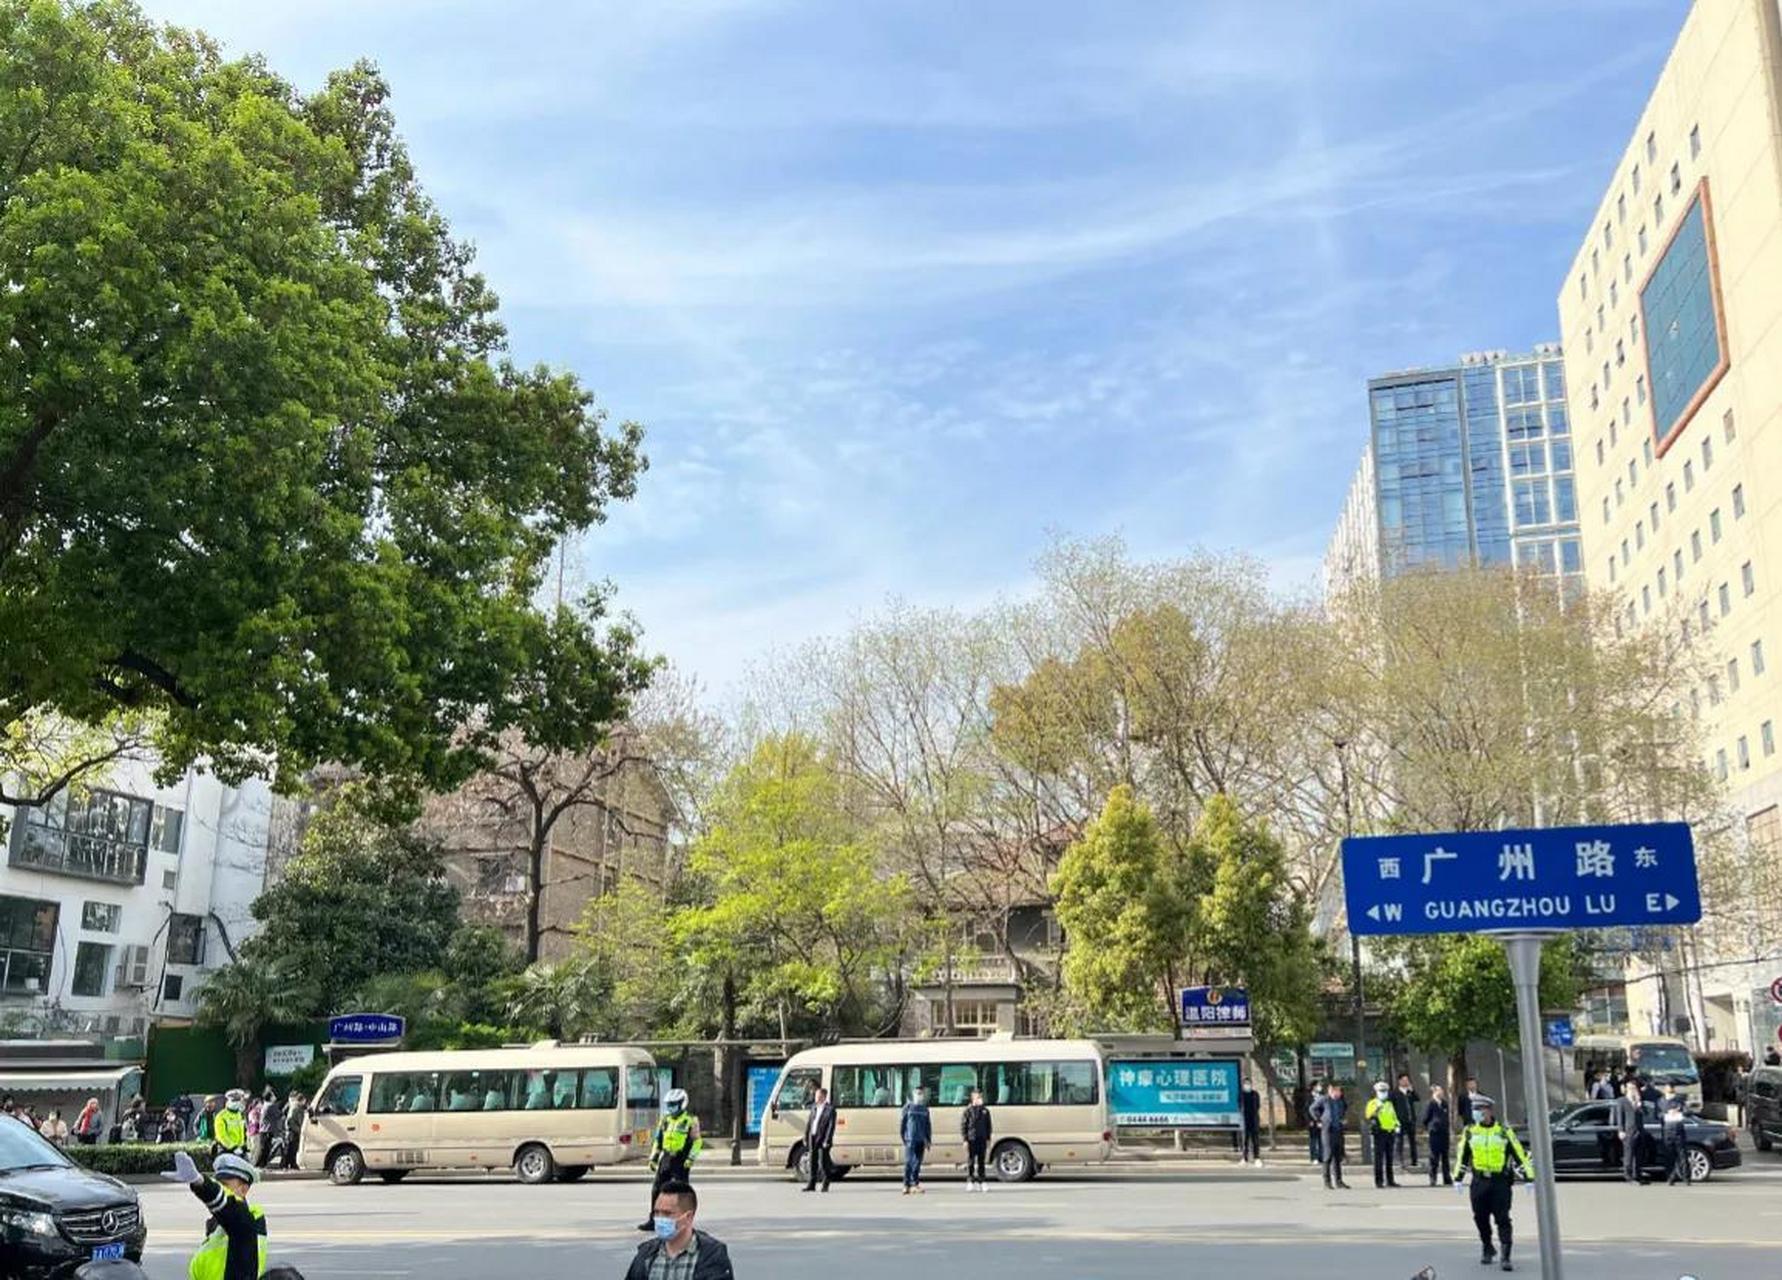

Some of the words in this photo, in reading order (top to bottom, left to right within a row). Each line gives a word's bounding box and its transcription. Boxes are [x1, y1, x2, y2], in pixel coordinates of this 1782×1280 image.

[1378, 857, 1401, 879] 西
[1421, 840, 1616, 884] 广州路
[1635, 847, 1658, 868] 东
[1384, 903, 1403, 922] W
[1425, 895, 1571, 919] GUANGZHOU
[1585, 894, 1616, 915] LU
[1646, 893, 1662, 913] E
